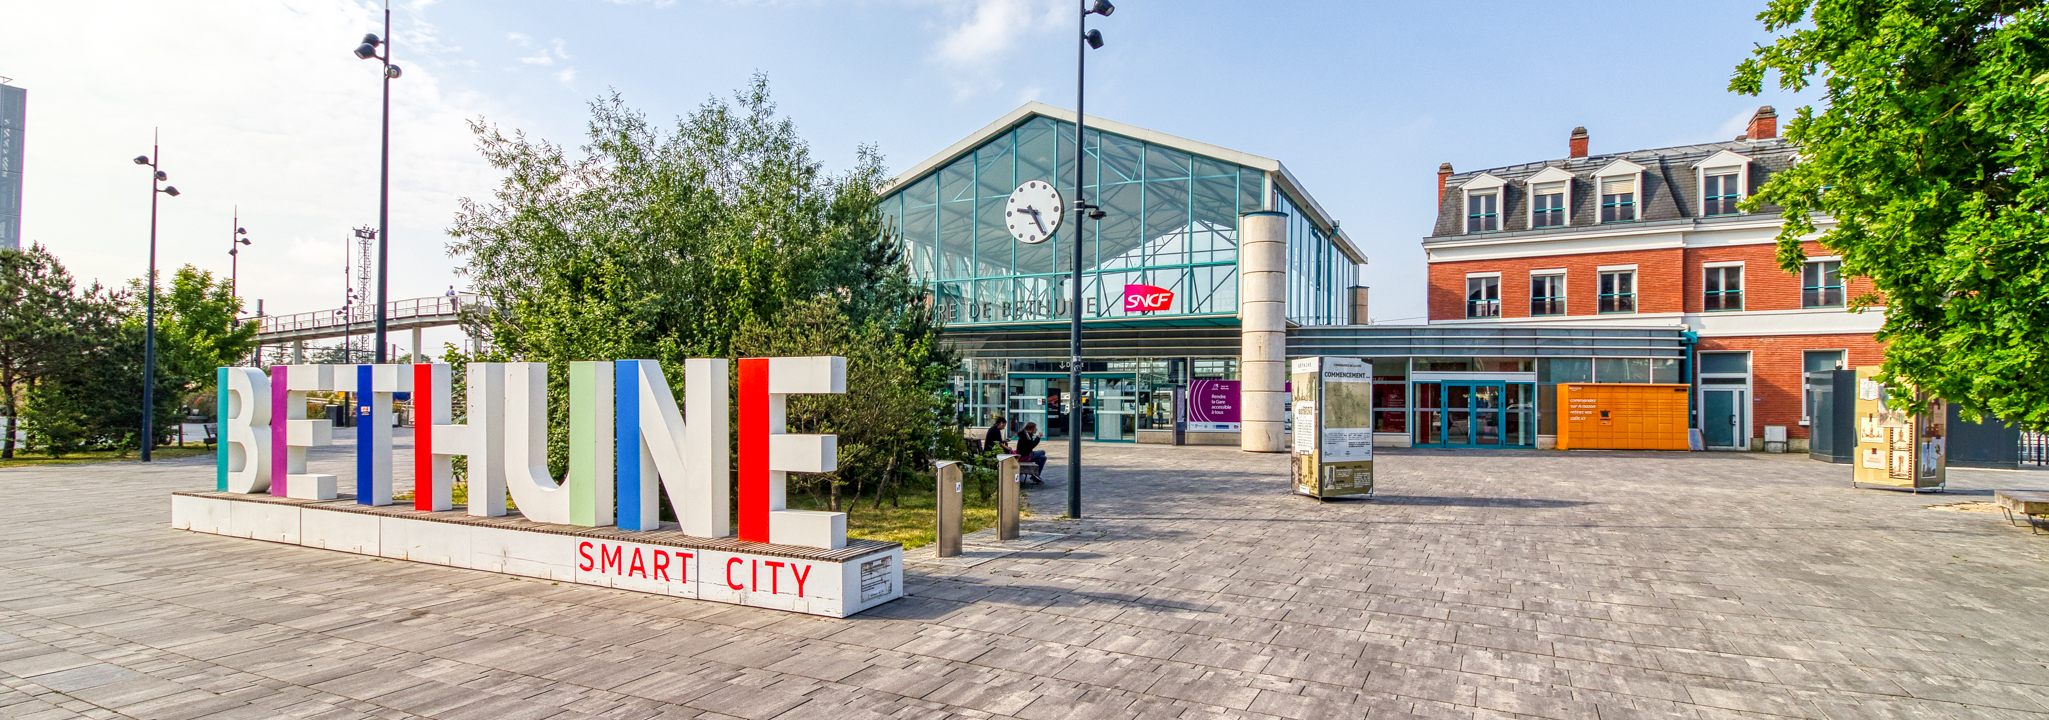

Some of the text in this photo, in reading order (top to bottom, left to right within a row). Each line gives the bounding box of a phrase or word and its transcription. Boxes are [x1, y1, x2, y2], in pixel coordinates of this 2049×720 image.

[1126, 293, 1171, 308] SNCF
[969, 301, 992, 320] DE
[1324, 371, 1366, 379] COMMENCEMENT
[217, 356, 848, 549] BETHUNE
[579, 541, 694, 584] SMART
[726, 556, 812, 598] CITY
